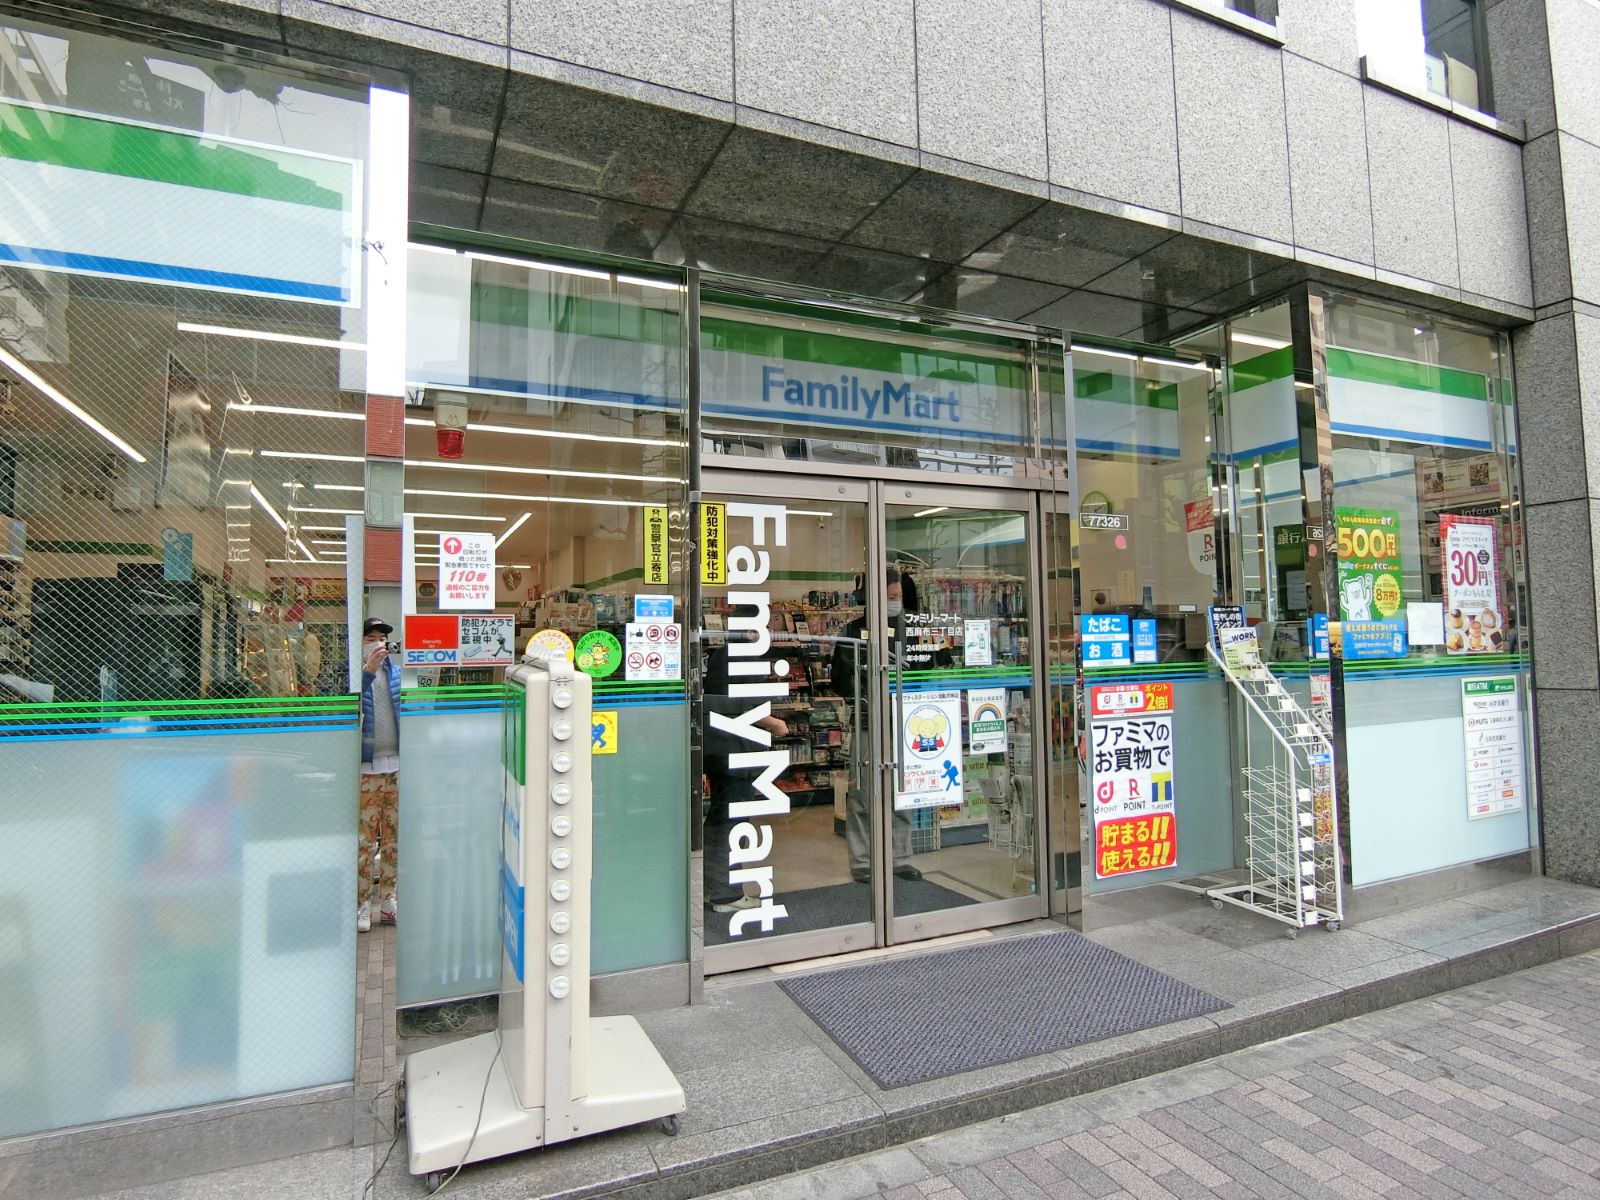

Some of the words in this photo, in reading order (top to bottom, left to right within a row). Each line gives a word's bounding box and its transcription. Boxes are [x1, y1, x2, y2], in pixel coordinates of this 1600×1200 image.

[762, 365, 960, 422] FamilyMart
[1089, 515, 1121, 528] 77326
[706, 506, 718, 581] 防犯対策強化中
[1277, 532, 1304, 545] 銀行
[651, 523, 662, 582] 警察官立寄店
[1199, 553, 1216, 562] POIN
[450, 570, 487, 582] 110番
[462, 618, 513, 627] 防犯カメラで
[905, 613, 962, 623] ファミリーマート
[463, 627, 499, 635] セコムが
[905, 626, 963, 637] 西麻布三丁目店
[1087, 617, 1122, 633] たばこ
[462, 636, 492, 644] 監視中
[407, 650, 457, 662] SECOM
[1145, 683, 1168, 692] ポイント
[1145, 692, 1169, 711] 2倍!
[710, 502, 790, 937] FamilyMart
[1093, 721, 1170, 747] ファミマの
[1095, 745, 1171, 773] お買物で
[1123, 801, 1146, 811] POINT
[1101, 816, 1170, 848] 貯まる!!
[1101, 841, 1171, 874] 使える!!
